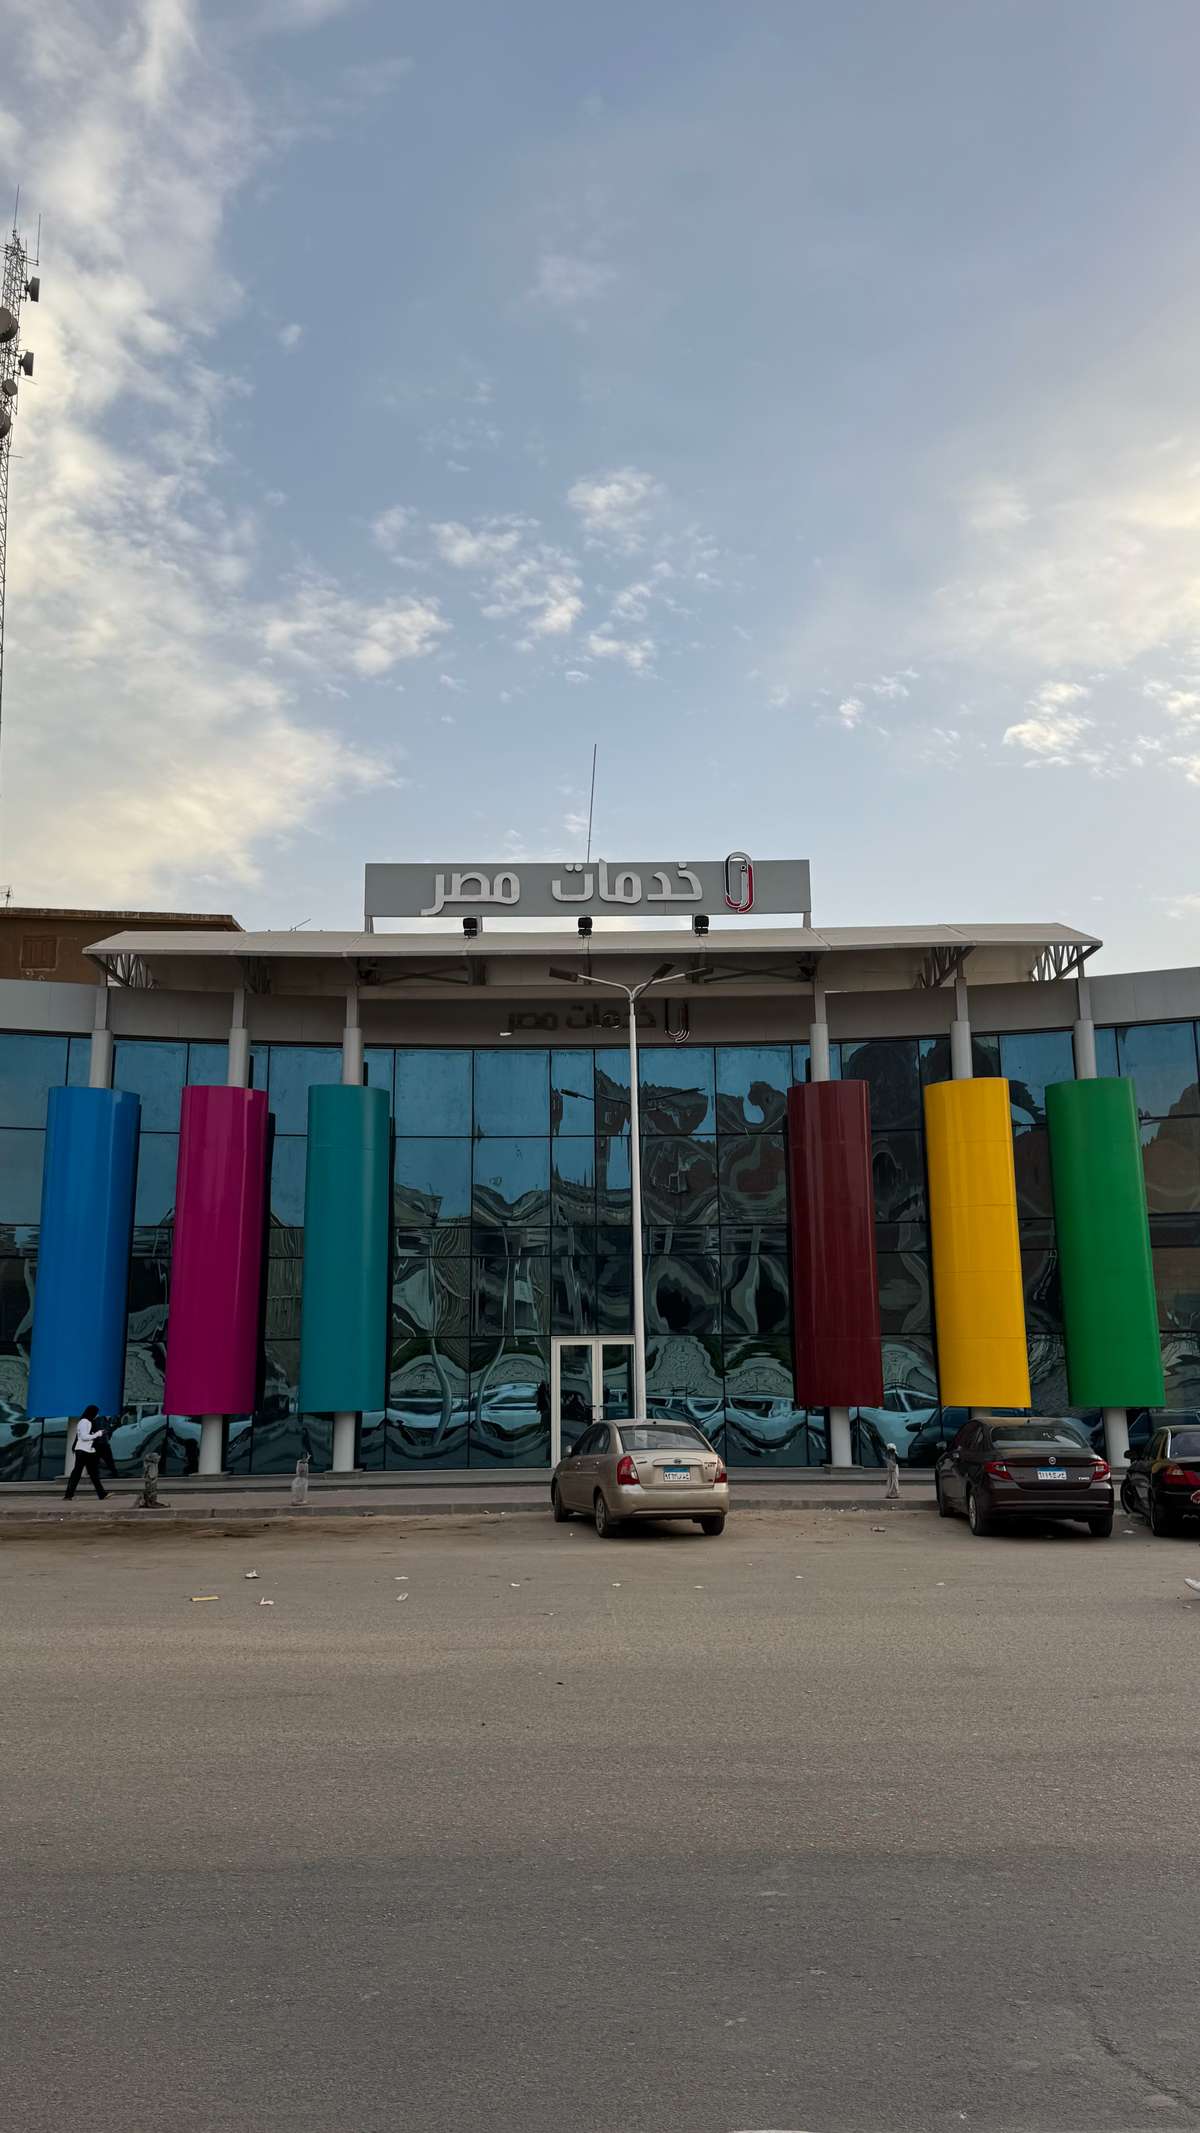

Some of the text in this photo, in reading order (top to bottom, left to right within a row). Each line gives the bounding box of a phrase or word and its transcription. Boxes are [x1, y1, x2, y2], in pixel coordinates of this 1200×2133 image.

[420, 858, 703, 916] خدمات مصر
[500, 1012, 559, 1036] مصر
